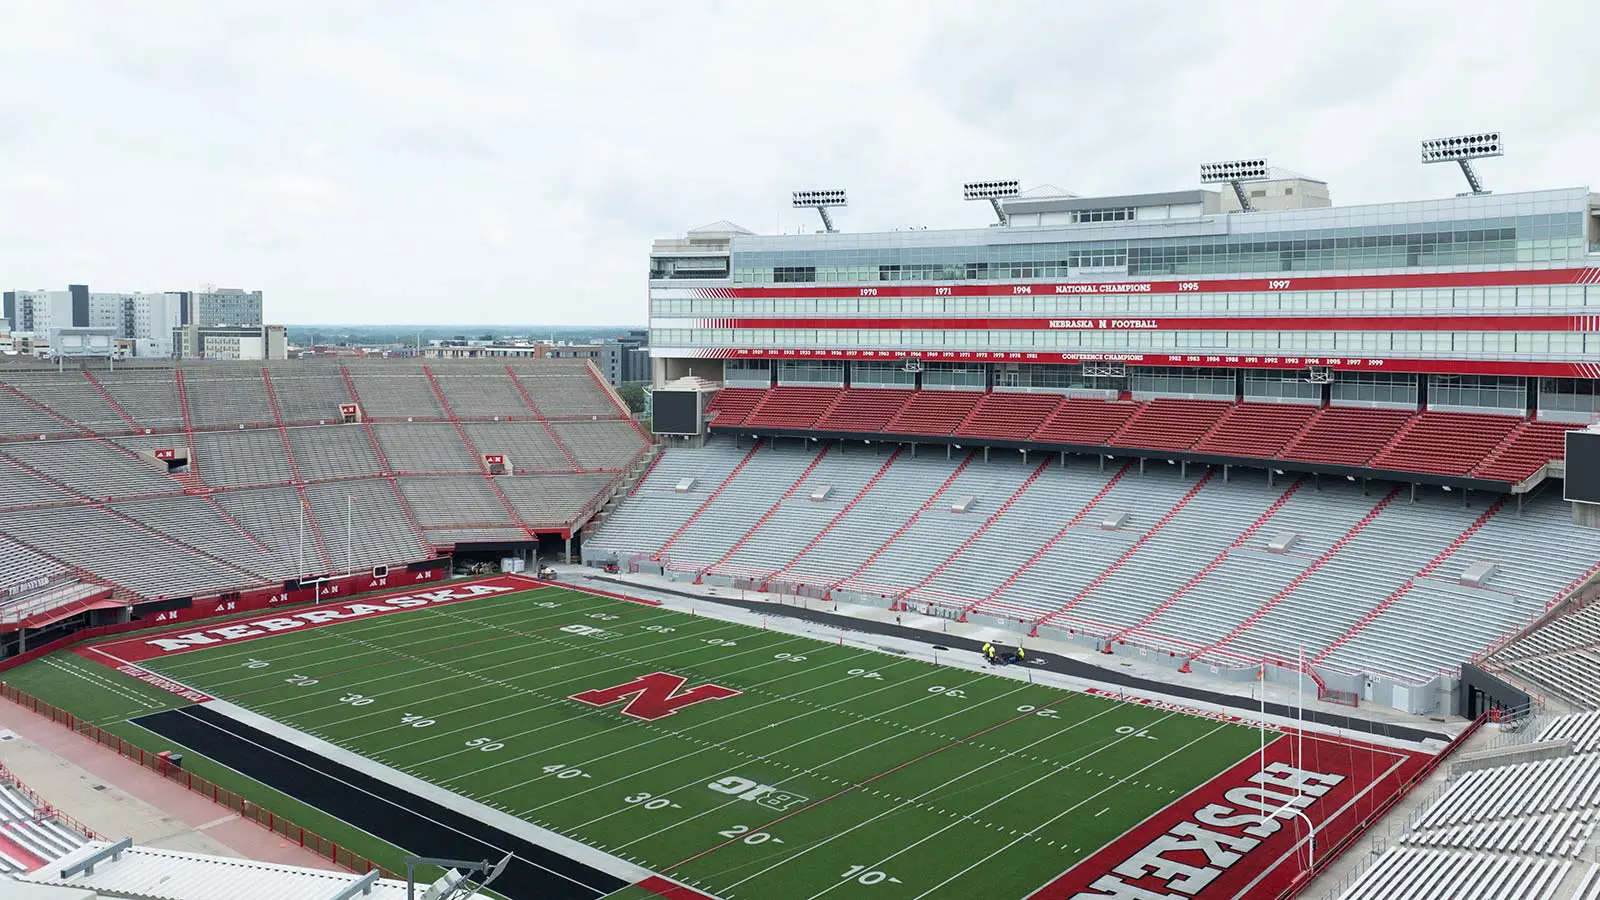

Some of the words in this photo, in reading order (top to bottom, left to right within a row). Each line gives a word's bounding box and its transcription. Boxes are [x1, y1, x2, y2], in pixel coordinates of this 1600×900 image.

[860, 288, 878, 296] 1970
[935, 287, 952, 295] 1971
[1012, 286, 1031, 294] 1994
[1056, 285, 1098, 293] NATIONAL
[1099, 284, 1151, 293] CHAMPIONS
[1178, 283, 1199, 291] 1995
[1268, 280, 1290, 289] 1997
[1049, 320, 1093, 328] NEBRASKA
[1099, 320, 1106, 328] N
[1112, 320, 1157, 328] FOOTBALL
[145, 585, 514, 651] NEBRASKA
[707, 638, 738, 647] 40
[774, 652, 807, 663] 50
[847, 668, 883, 678] 40
[285, 675, 319, 686] 20
[567, 671, 744, 721] N
[927, 685, 965, 697] 30
[339, 694, 375, 706] 30
[1016, 704, 1058, 717] 20
[401, 716, 436, 728] 40
[1115, 726, 1153, 740] 10
[465, 737, 505, 752] 50
[542, 764, 582, 779] 40
[624, 792, 671, 810] 30
[718, 825, 771, 845] 20
[841, 865, 886, 885] 10
